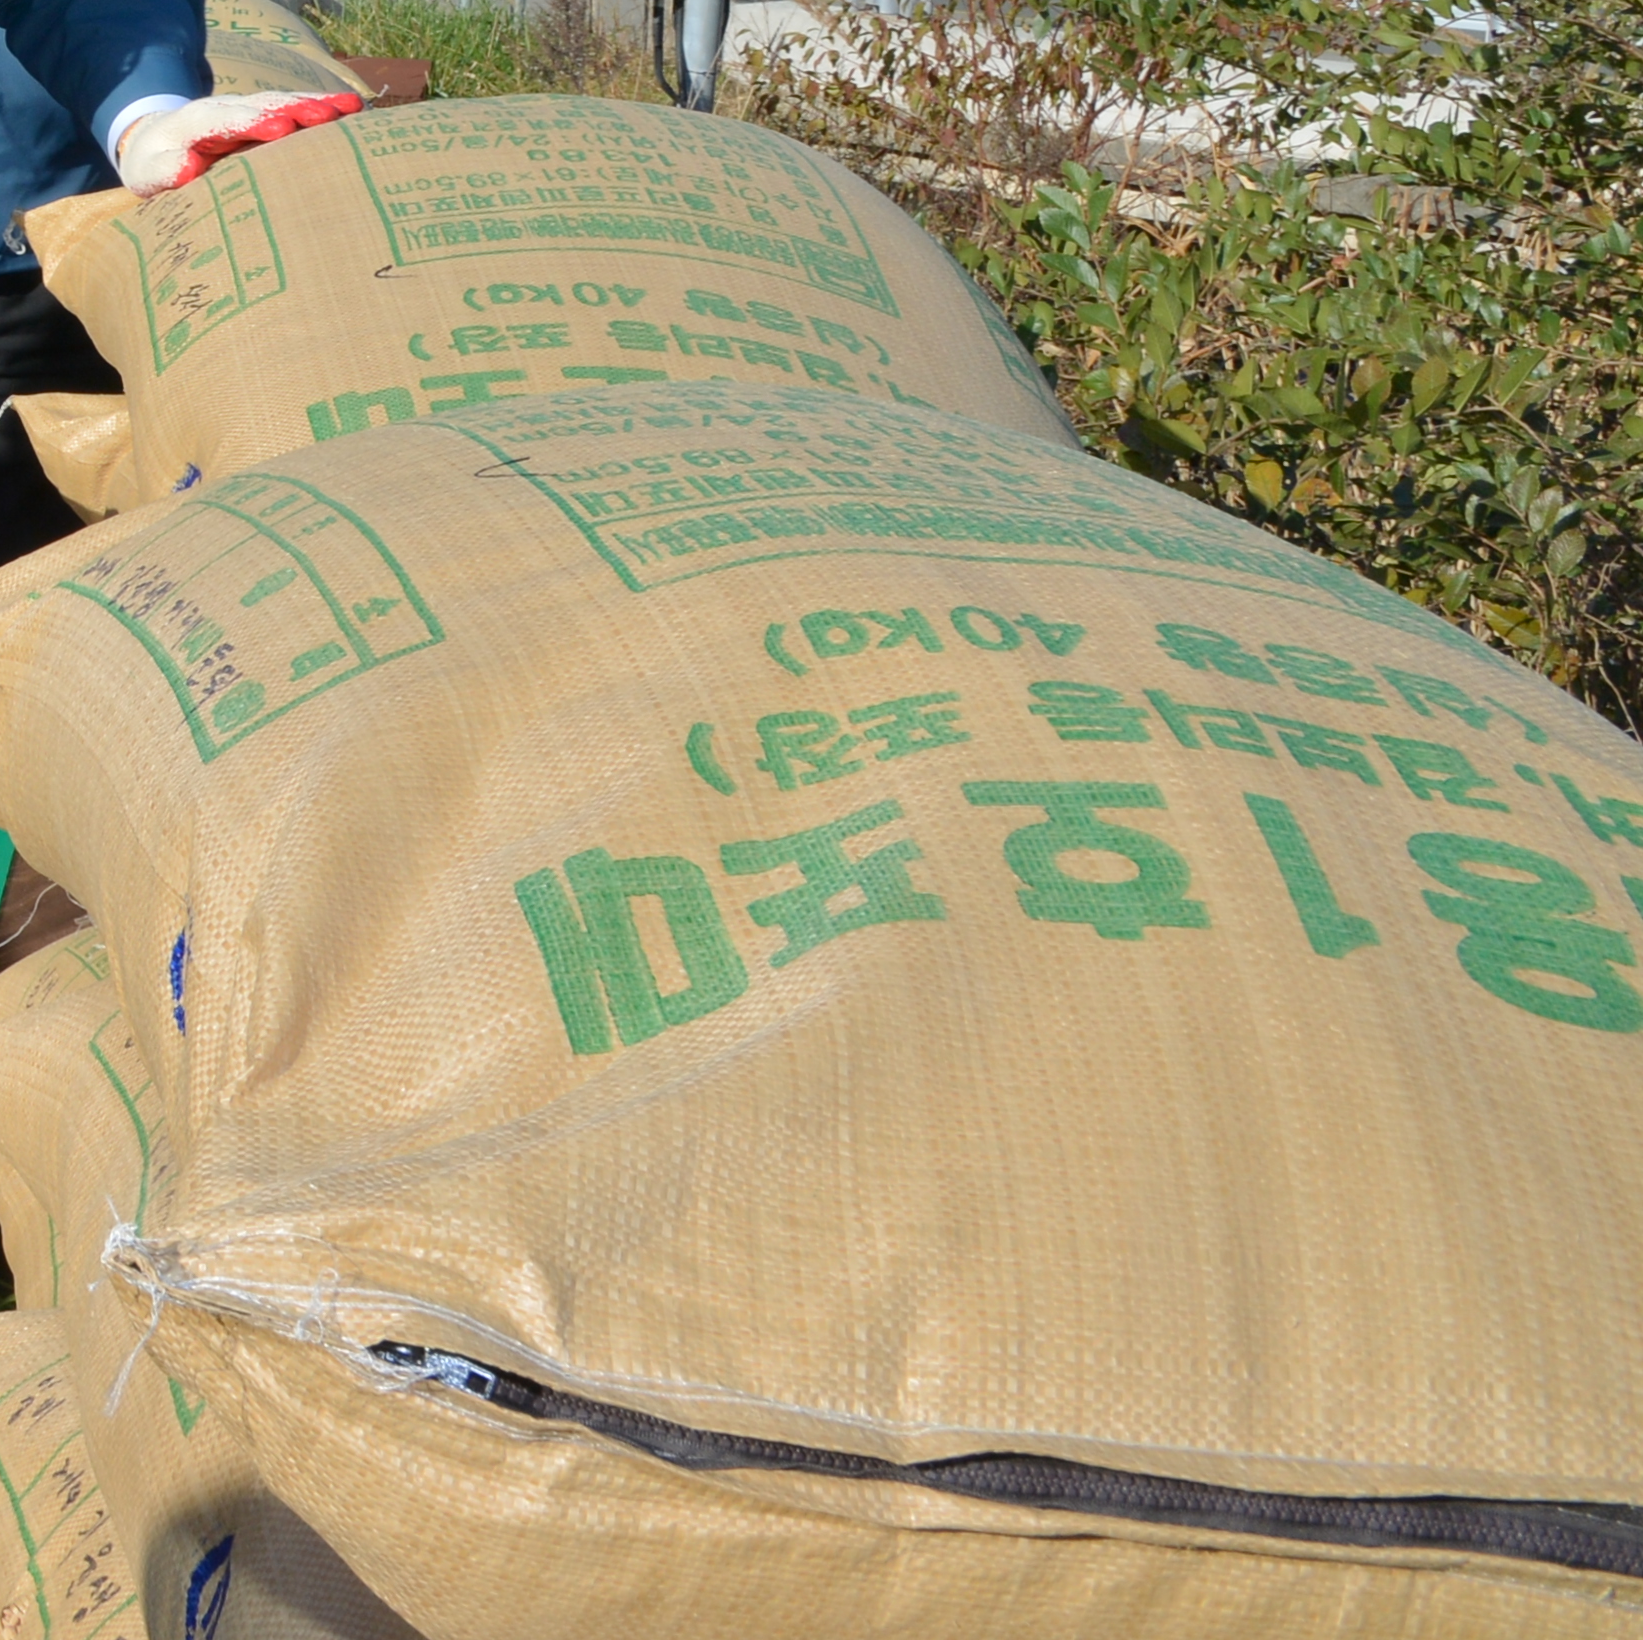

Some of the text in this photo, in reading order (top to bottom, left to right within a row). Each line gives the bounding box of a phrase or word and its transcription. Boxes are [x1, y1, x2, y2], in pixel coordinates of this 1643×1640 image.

[464, 281, 648, 312] 40kg)
[408, 321, 571, 361] 포장)
[764, 604, 1549, 746] (실중량 40kg)
[685, 692, 971, 795] 포장)
